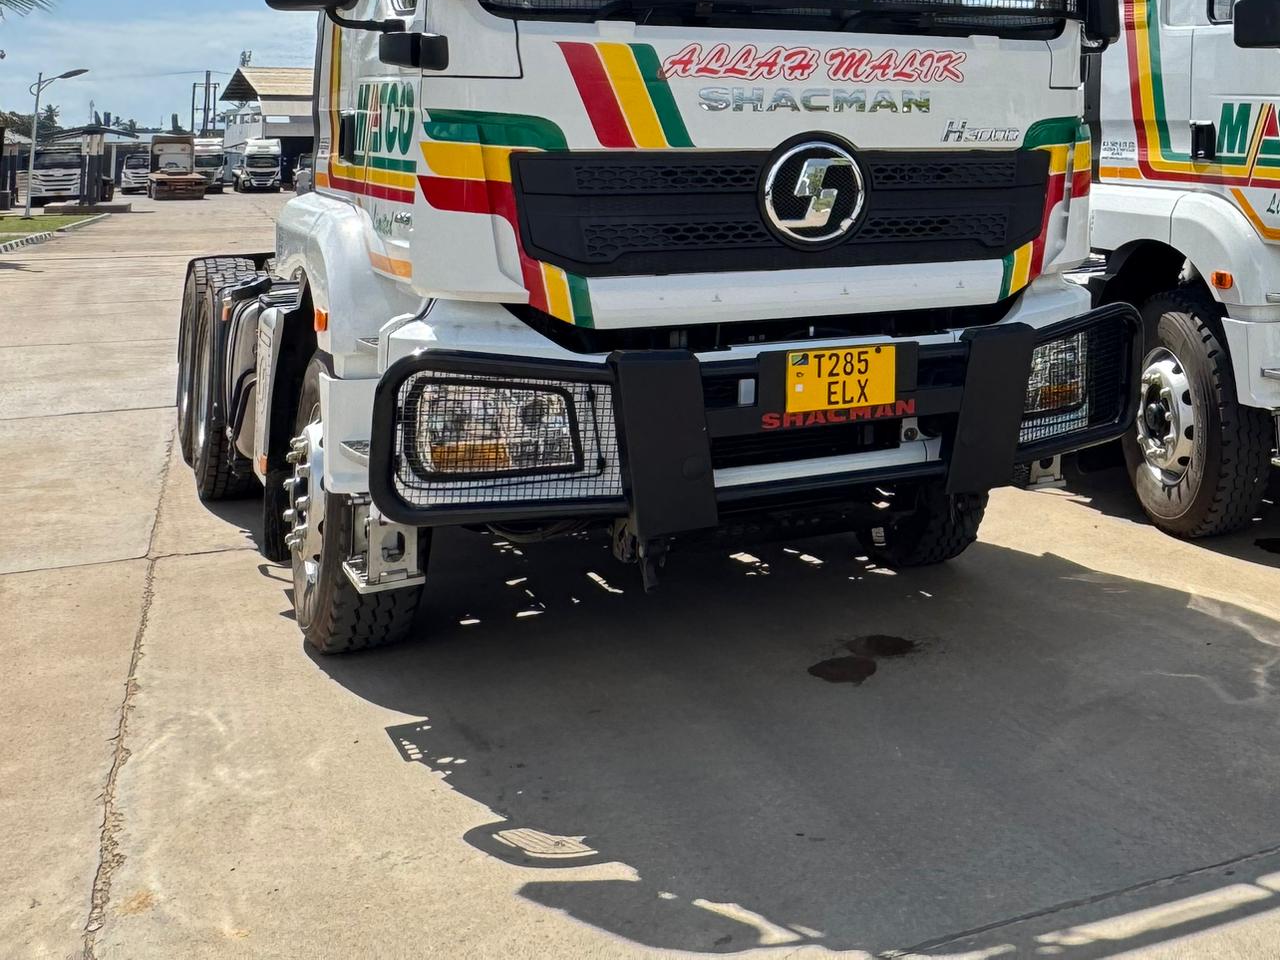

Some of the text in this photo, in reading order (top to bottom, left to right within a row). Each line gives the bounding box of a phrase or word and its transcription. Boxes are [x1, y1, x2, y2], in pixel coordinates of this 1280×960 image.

[660, 43, 968, 83] ALLAH MALIK
[699, 86, 931, 113] SHACMAN
[813, 351, 869, 378] T285
[827, 378, 869, 405] ELX
[761, 399, 916, 429] SHACMAN
